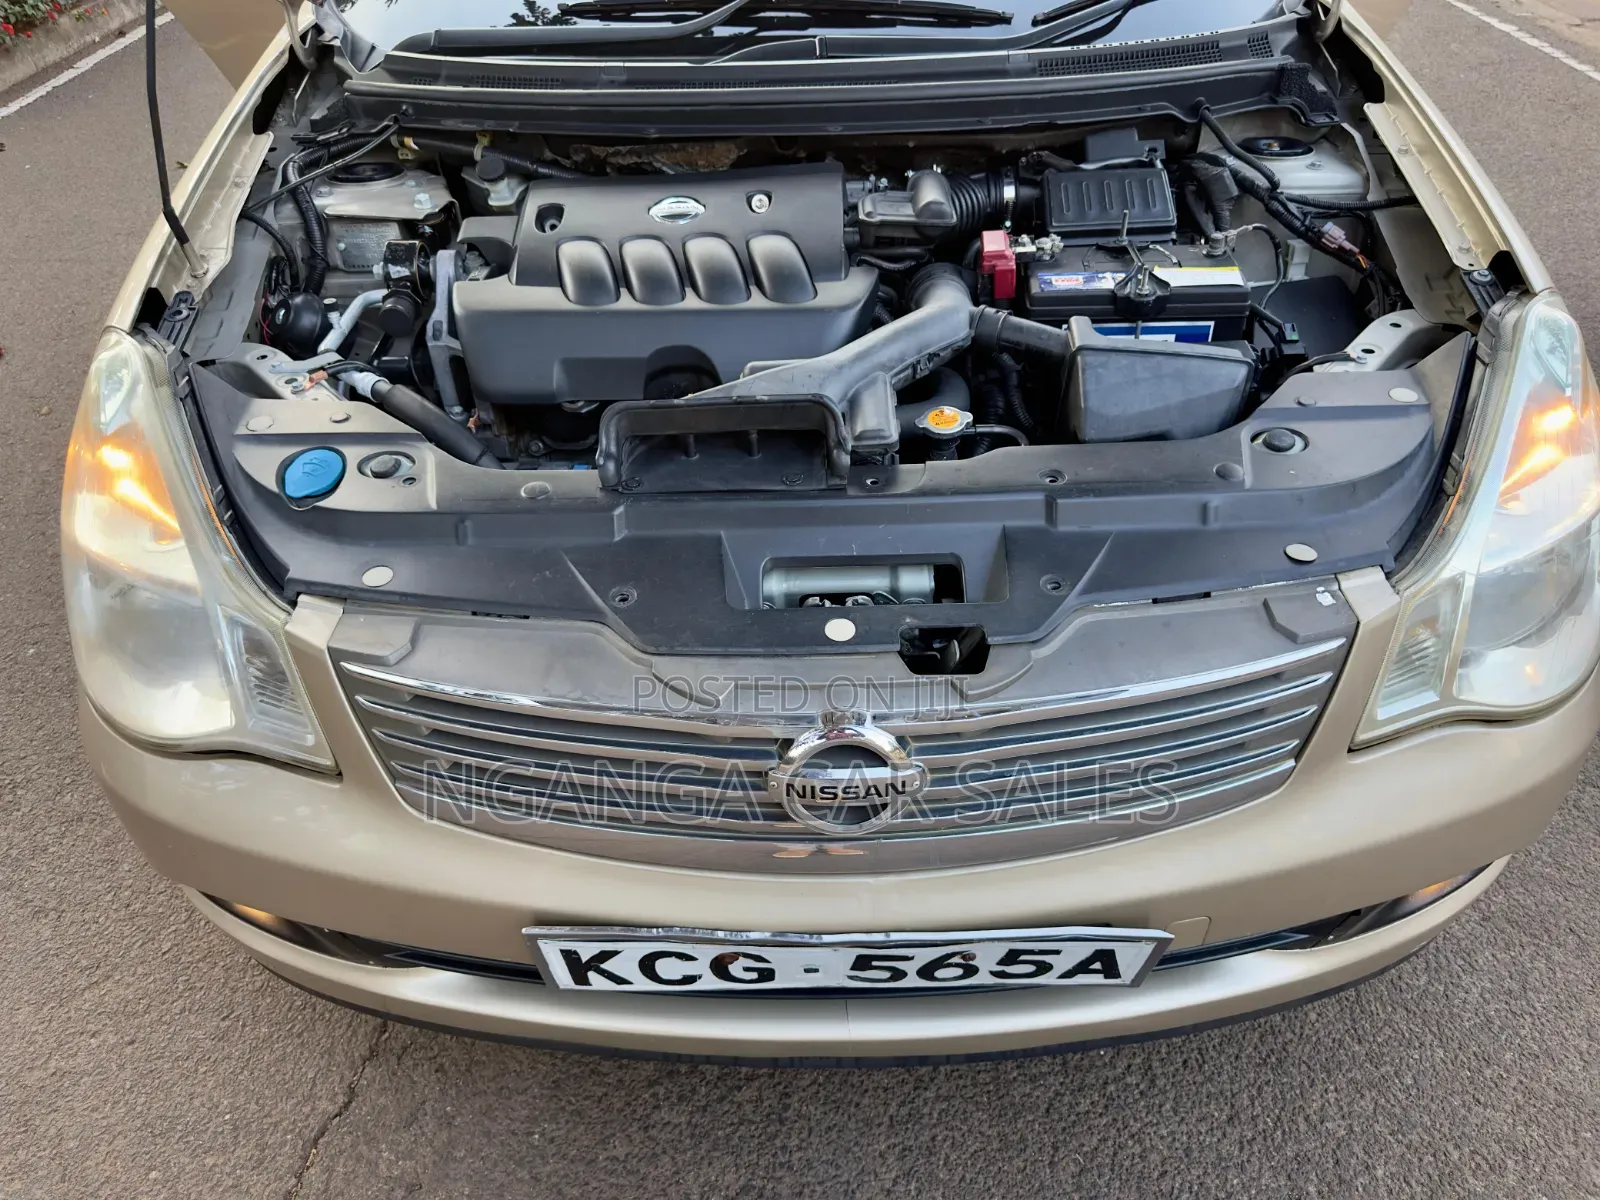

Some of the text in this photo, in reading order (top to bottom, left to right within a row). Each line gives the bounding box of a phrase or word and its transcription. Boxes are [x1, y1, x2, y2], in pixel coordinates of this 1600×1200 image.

[785, 780, 906, 801] NISSAN
[559, 948, 1122, 986] KCG 565A
